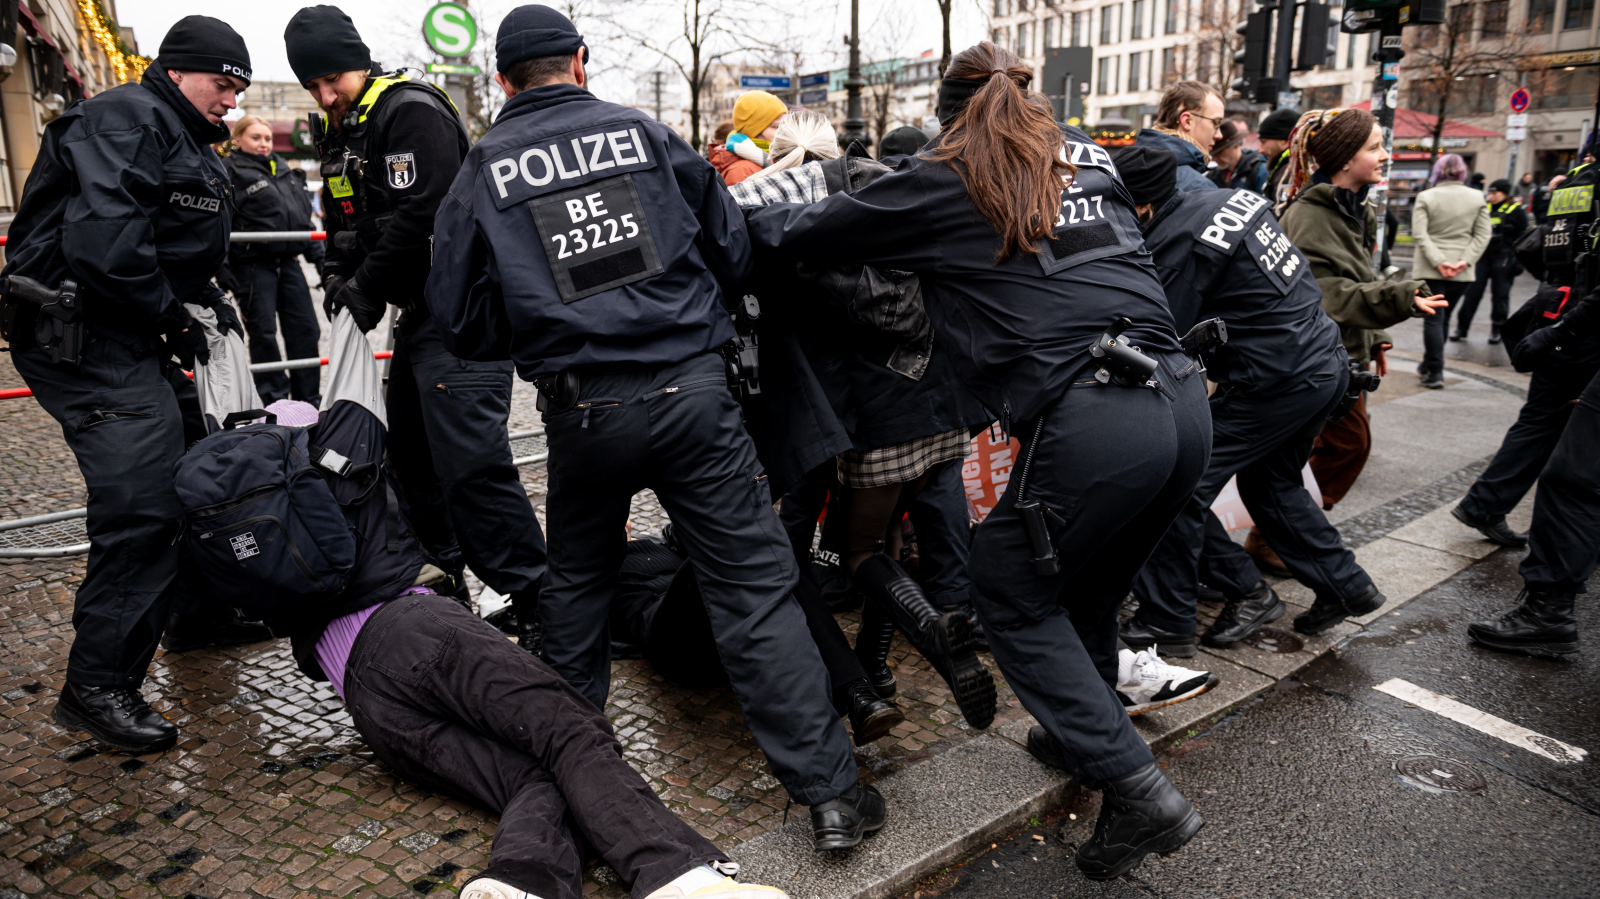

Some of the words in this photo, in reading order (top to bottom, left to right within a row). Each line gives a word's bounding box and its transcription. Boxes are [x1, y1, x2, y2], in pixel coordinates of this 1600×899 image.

[431, 6, 471, 54] S
[387, 155, 412, 165] POLIZEI
[490, 128, 648, 199] POLIZEI
[169, 192, 220, 213] POLIZEI
[565, 192, 609, 224] BE
[1201, 189, 1268, 250] POLIZEI
[551, 213, 640, 260] 23225
[1255, 222, 1277, 247] BE
[1260, 232, 1291, 271] 21300
